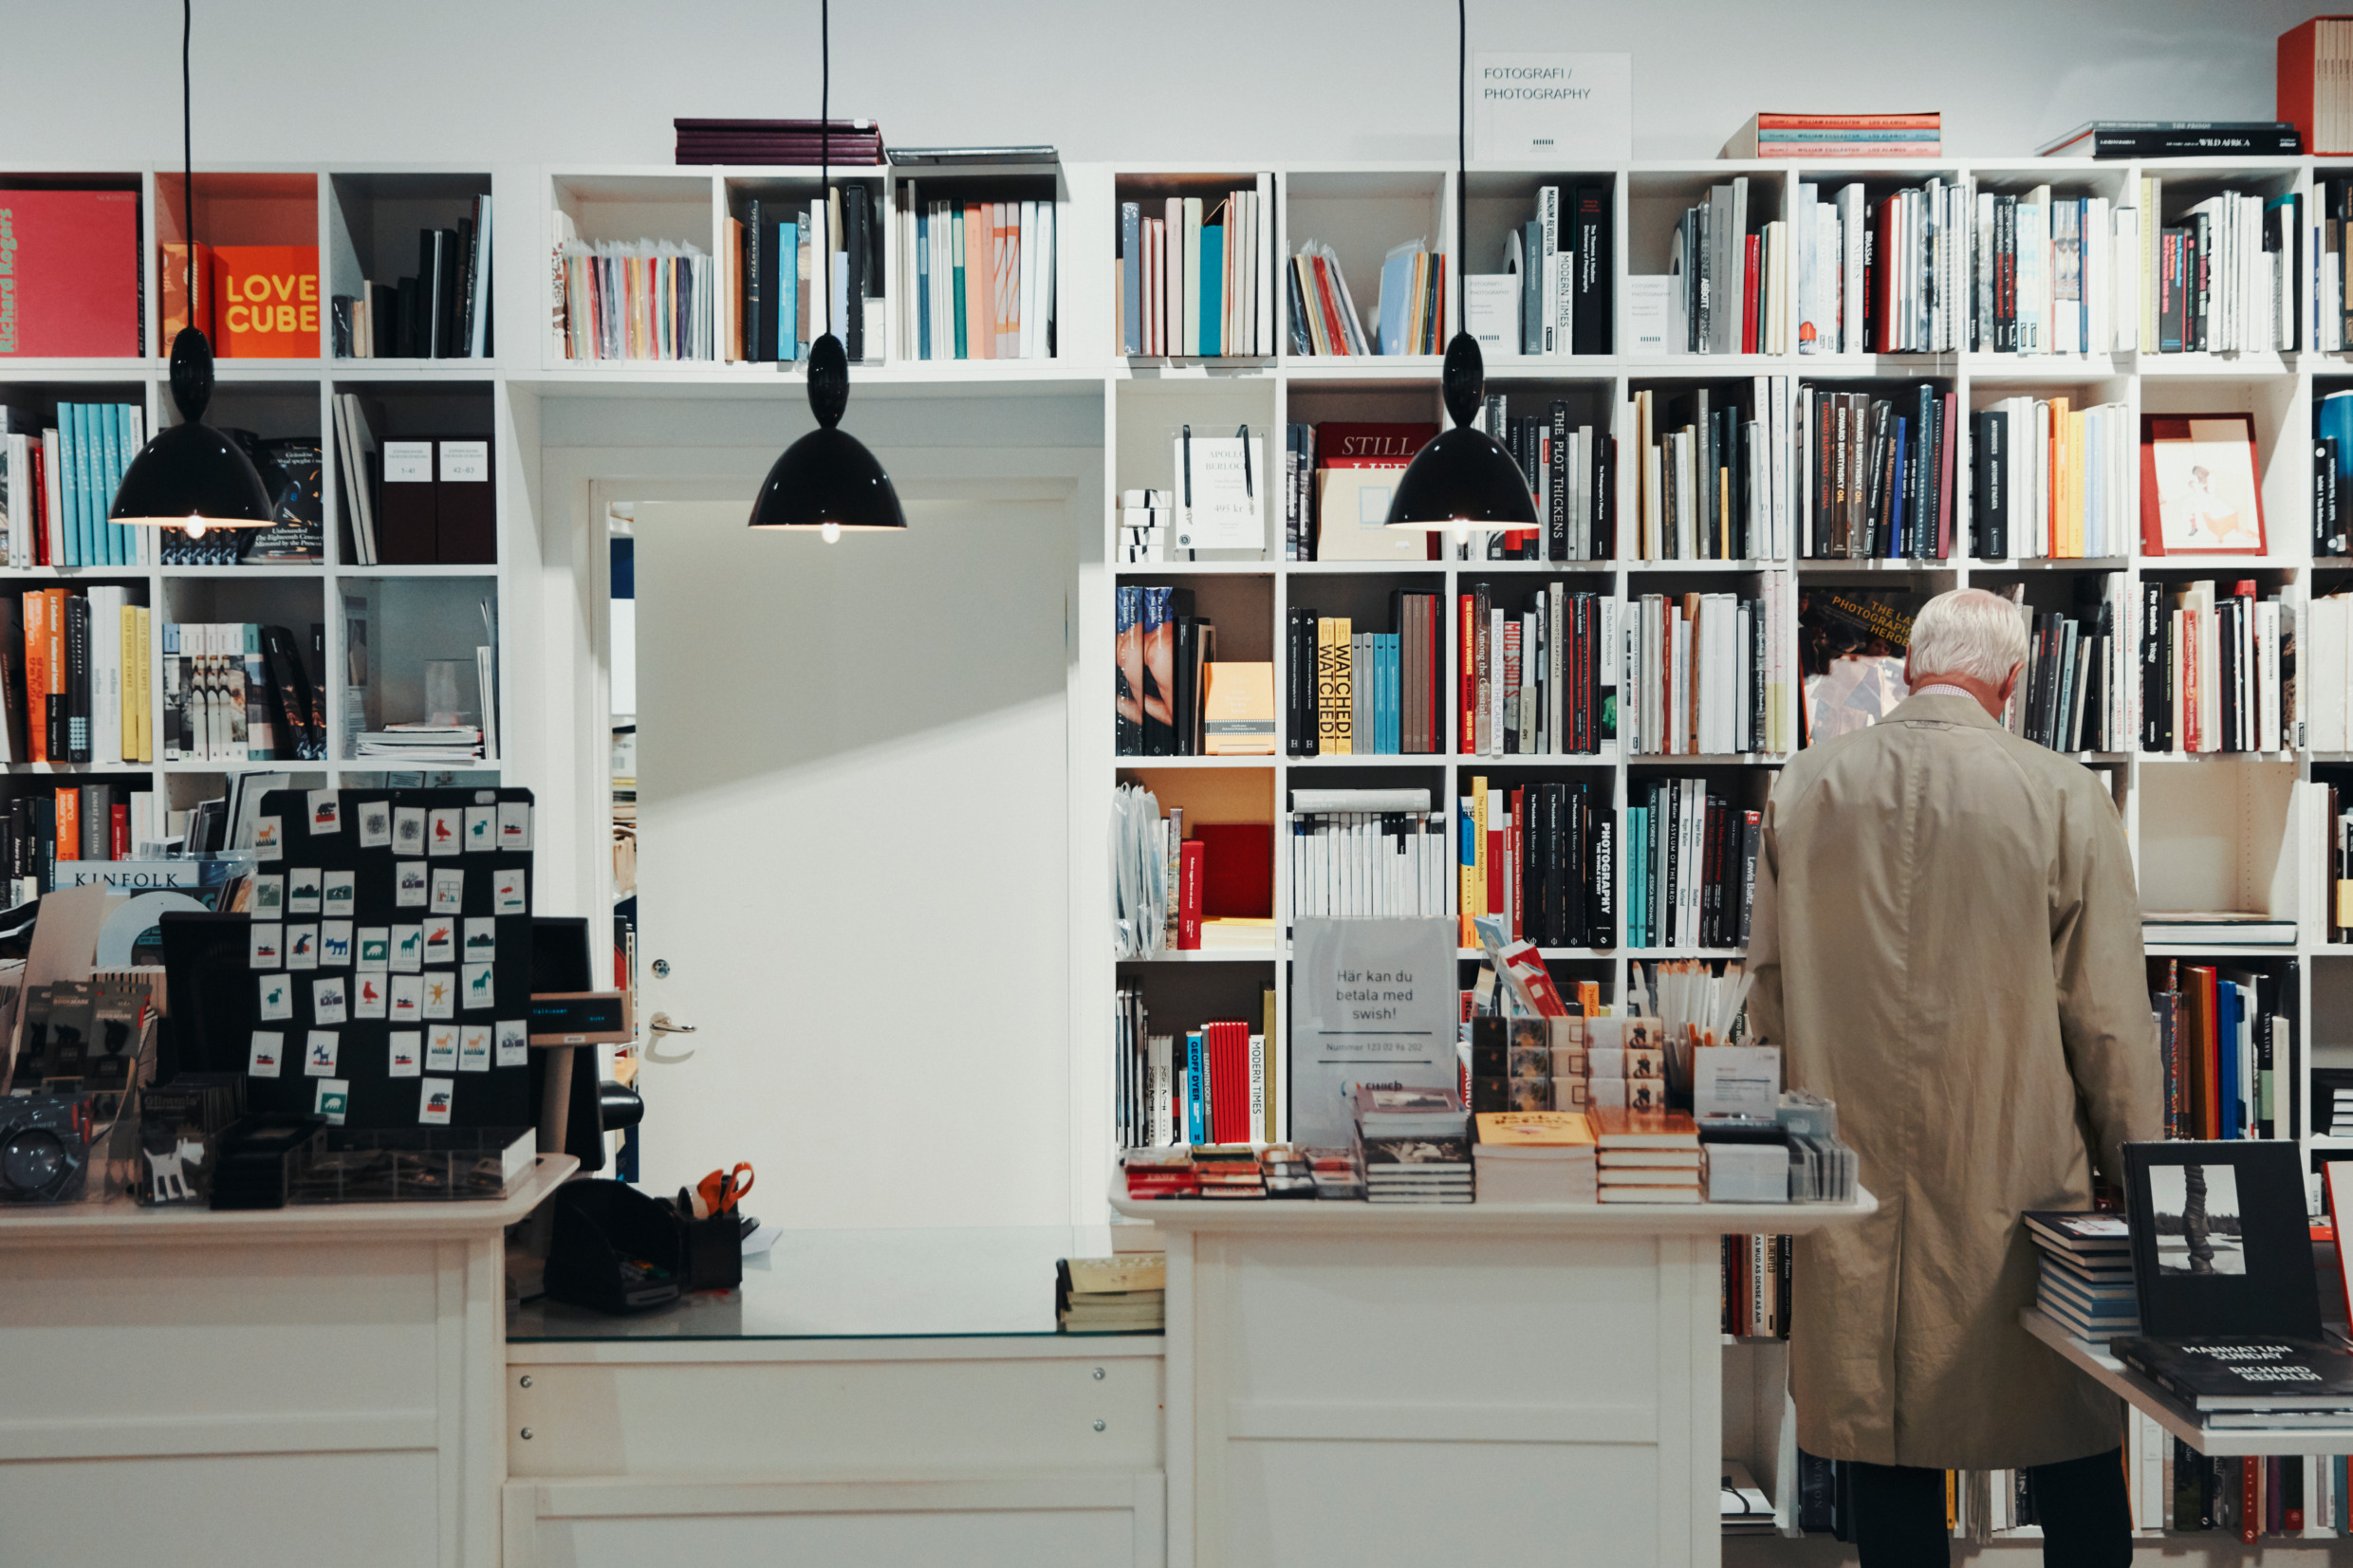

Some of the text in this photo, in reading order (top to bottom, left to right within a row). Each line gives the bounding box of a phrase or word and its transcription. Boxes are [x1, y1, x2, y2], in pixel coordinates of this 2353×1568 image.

[1484, 67, 1564, 80] FOTOGRAFI
[1484, 88, 1591, 100] PHOTOGRAPHY
[0, 208, 18, 353] Richard Rogers
[227, 274, 319, 302] LOVE
[1561, 255, 1569, 327] MODERN TIMES
[226, 305, 320, 333] CUBE
[1342, 436, 1416, 456] STILL
[1837, 408, 1845, 504] EDWARD BURTYNSKY OIL
[1855, 409, 1863, 505] EDWARD BURTYNSKY OIL
[1206, 462, 1247, 470] BERLOC
[1554, 411, 1565, 539] THE PLOT THICKENS
[1885, 457, 1895, 490] Margaret
[1234, 504, 1247, 513] kr
[1882, 491, 1892, 526] Cameron
[1832, 596, 1913, 638] PHOTOGRAPH
[1872, 600, 1895, 618] THE
[1870, 625, 1911, 648] HEROE
[1504, 622, 1520, 698] MUG SHOTS
[2148, 642, 2158, 664] Trilogy
[1476, 628, 1488, 719] Among the Celestials
[1320, 644, 1334, 740] WATCHED!
[1336, 644, 1351, 740] WATCHED!
[1602, 822, 1611, 914] PHOTOGRAPHY
[1670, 854, 1676, 864] OF
[75, 873, 180, 888] KINFOLK
[1746, 857, 1755, 905] Lewis Baltz
[1337, 969, 1413, 983] Här kan du
[1336, 988, 1413, 1002] betala med
[1353, 1007, 1397, 1020] swish!
[1326, 1042, 1364, 1052] Nummer
[1366, 1042, 1381, 1052] 123
[1382, 1042, 1394, 1052] 02
[1408, 1042, 1423, 1052] 202
[1191, 1041, 1199, 1101] GEOFF DYER
[1252, 1042, 1261, 1115] MODERN TIMES
[1755, 1236, 1761, 1245] AS
[1768, 1238, 1776, 1273] BLUMENFELD
[1755, 1264, 1761, 1274] AS
[1755, 1301, 1761, 1311] AS
[2181, 1345, 2294, 1354] MANHATTAN
[2240, 1373, 2323, 1381] RENALDI
